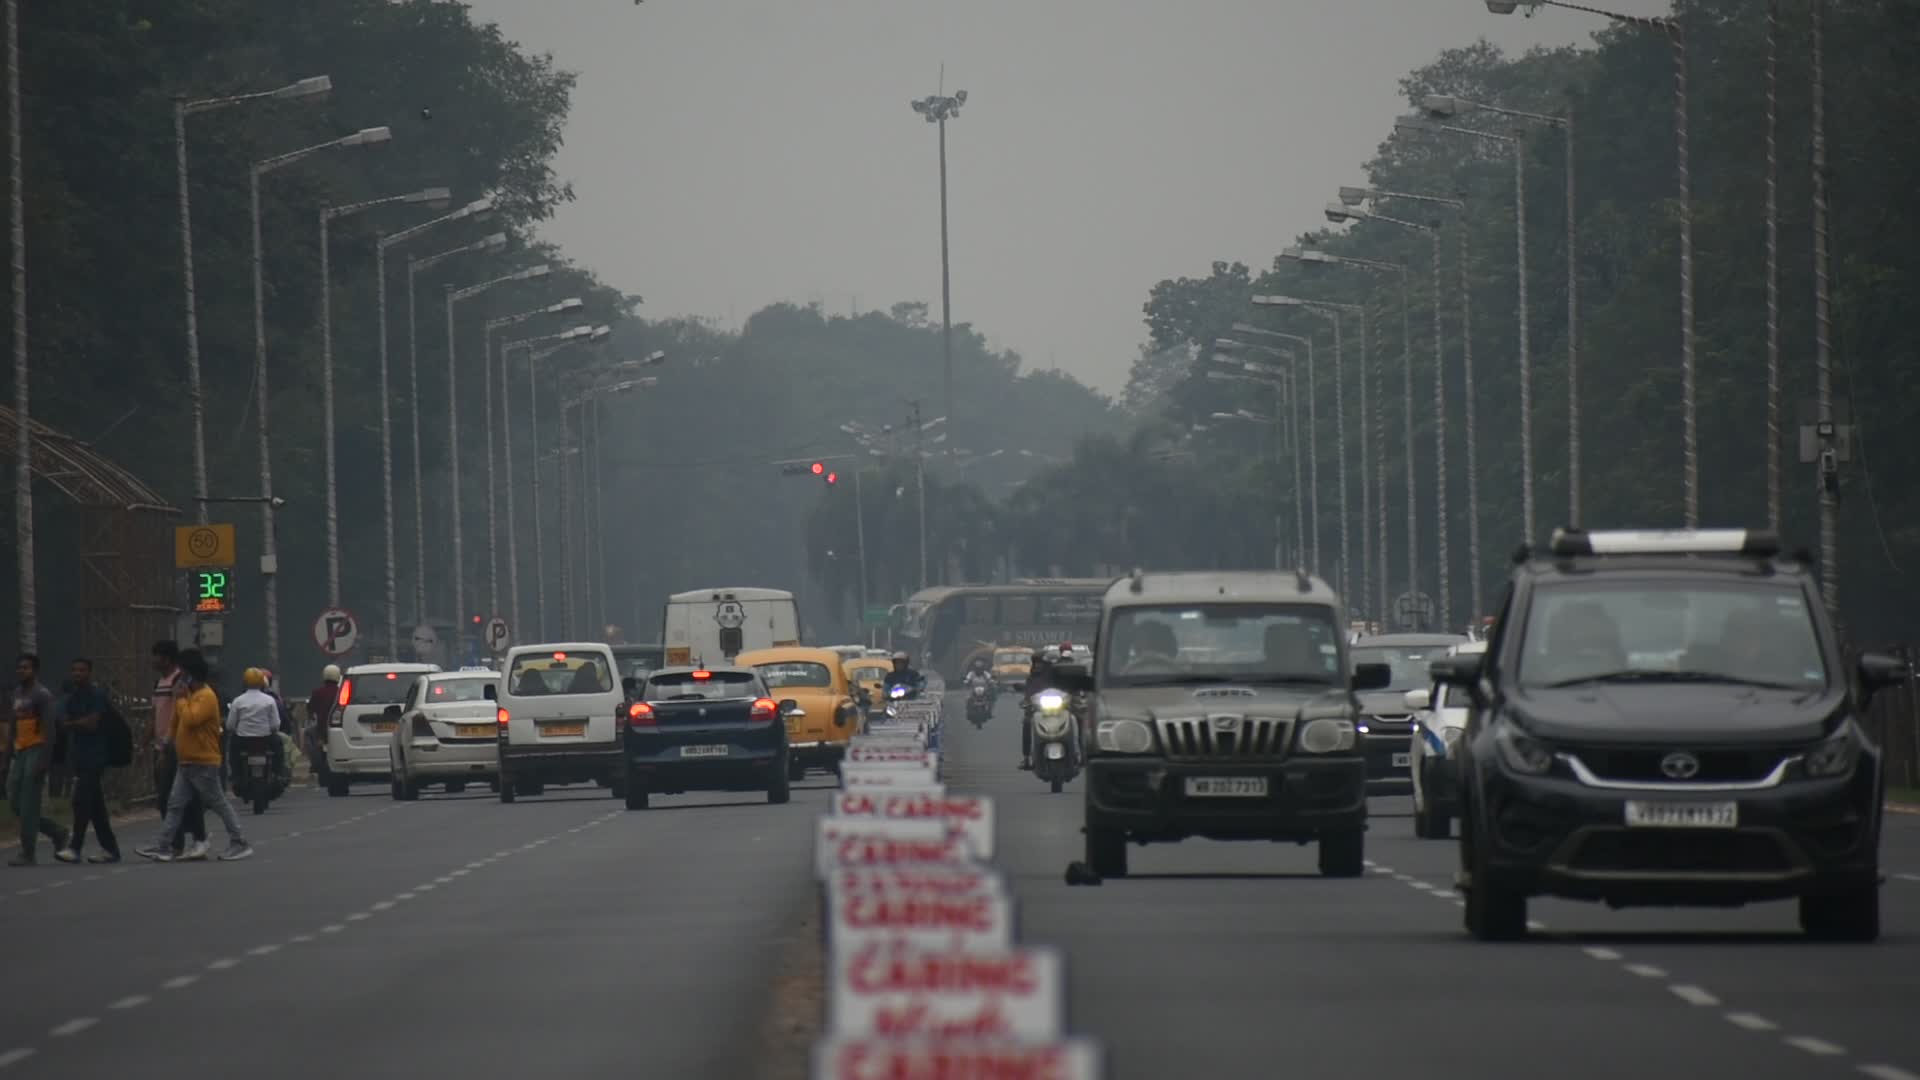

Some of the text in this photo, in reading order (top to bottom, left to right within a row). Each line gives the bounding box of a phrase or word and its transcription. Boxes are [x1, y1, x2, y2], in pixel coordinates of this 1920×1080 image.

[199, 573, 225, 598] 32
[843, 896, 994, 934] CARING
[848, 944, 1037, 997] CARING
